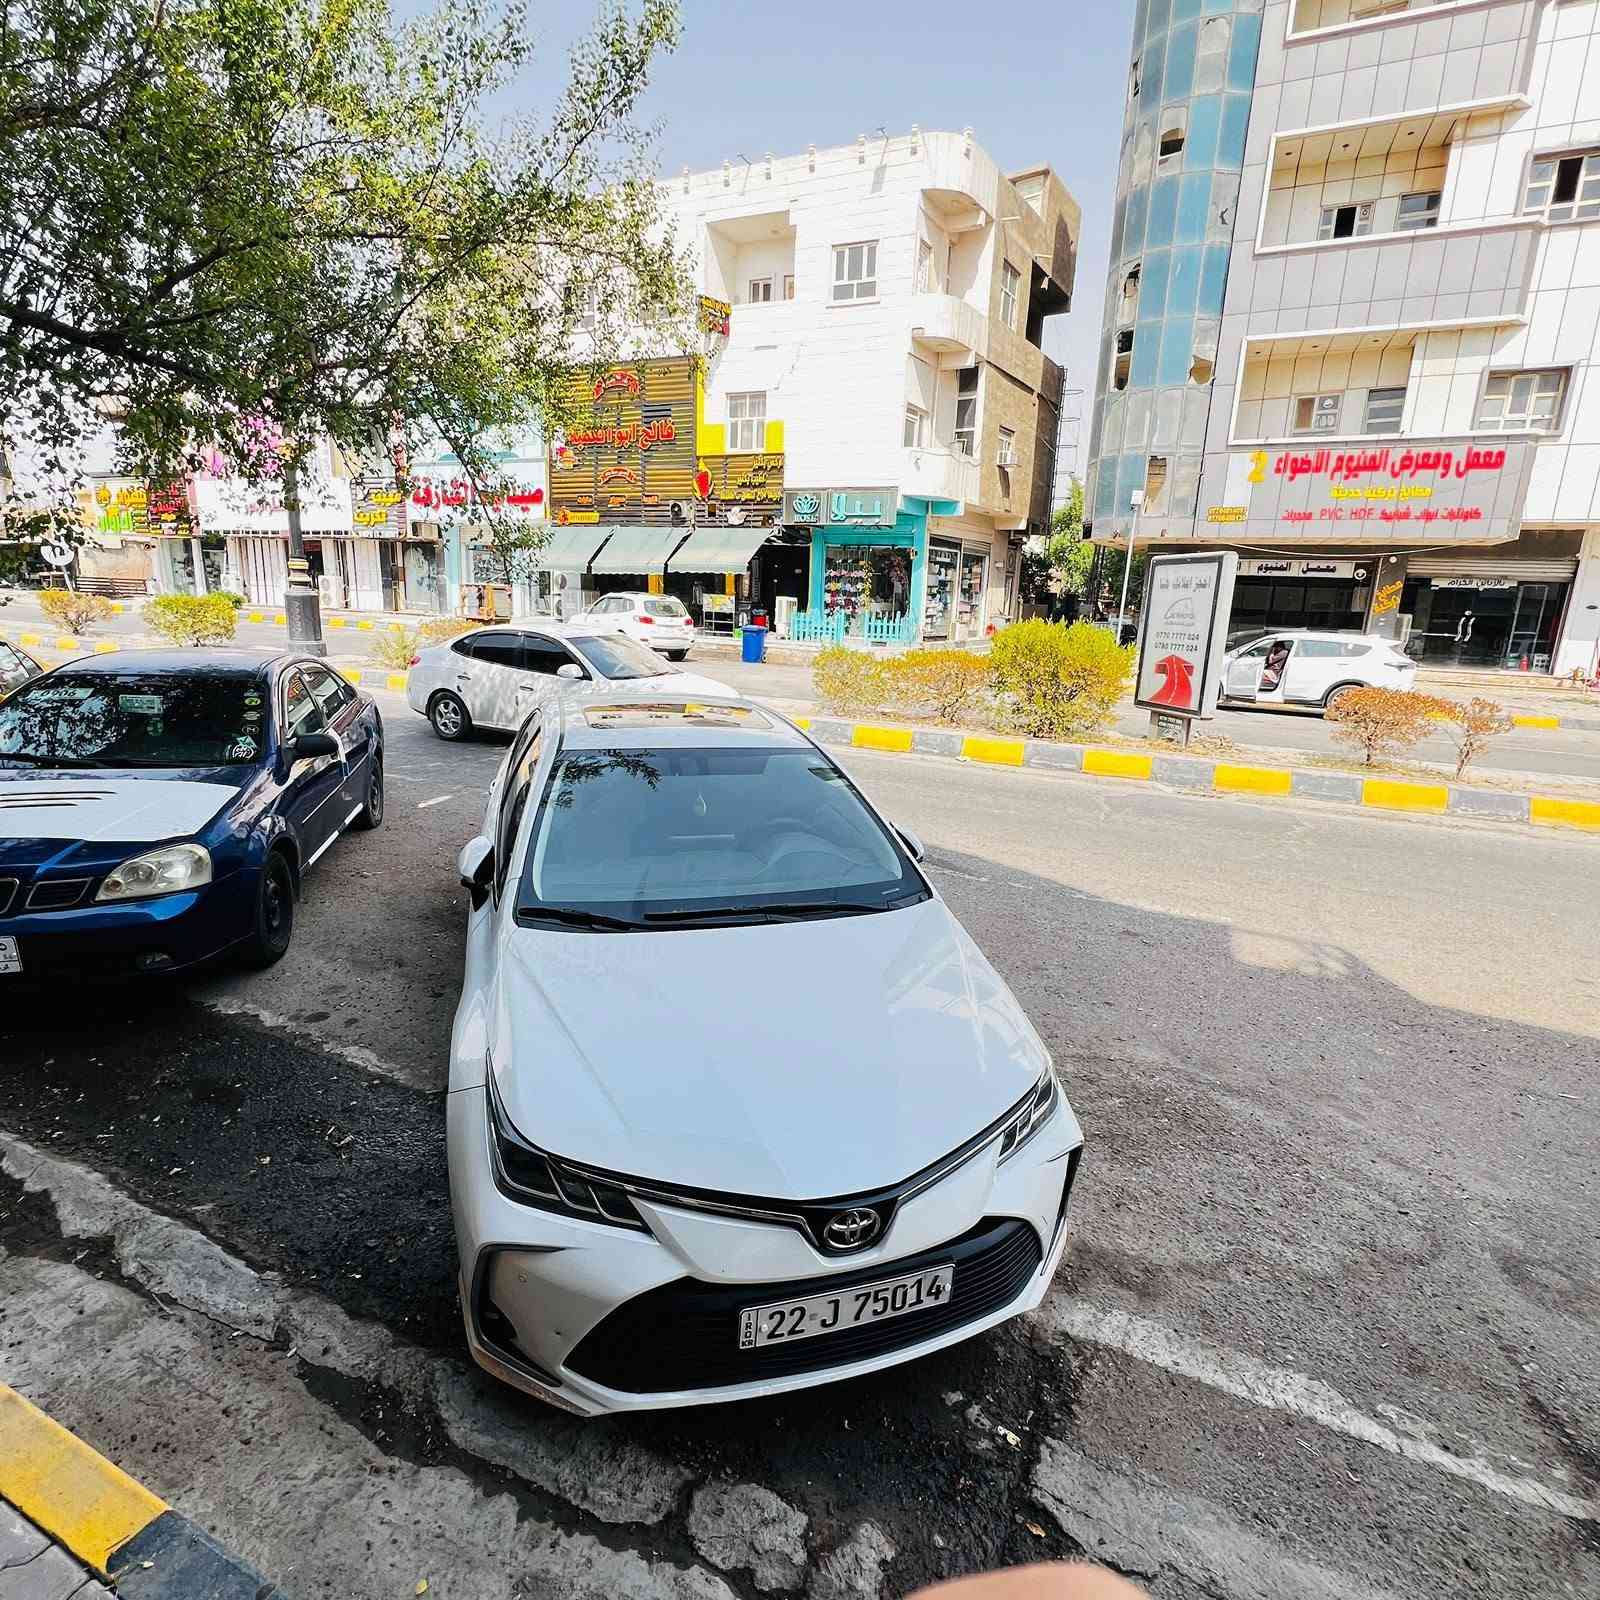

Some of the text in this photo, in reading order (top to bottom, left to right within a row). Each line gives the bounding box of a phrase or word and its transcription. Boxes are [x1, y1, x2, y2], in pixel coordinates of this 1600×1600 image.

[614, 423, 637, 448] ابو
[639, 417, 676, 450] فالح
[1248, 446, 1506, 483] معمل ومعرض المنيوم الاضواء 2
[1399, 485, 1433, 501] مطابخ
[1319, 507, 1344, 520] PVC
[1257, 561, 1292, 575] المنيوم
[1302, 561, 1337, 575] معمل
[767, 1274, 944, 1340] 22 J 75014
